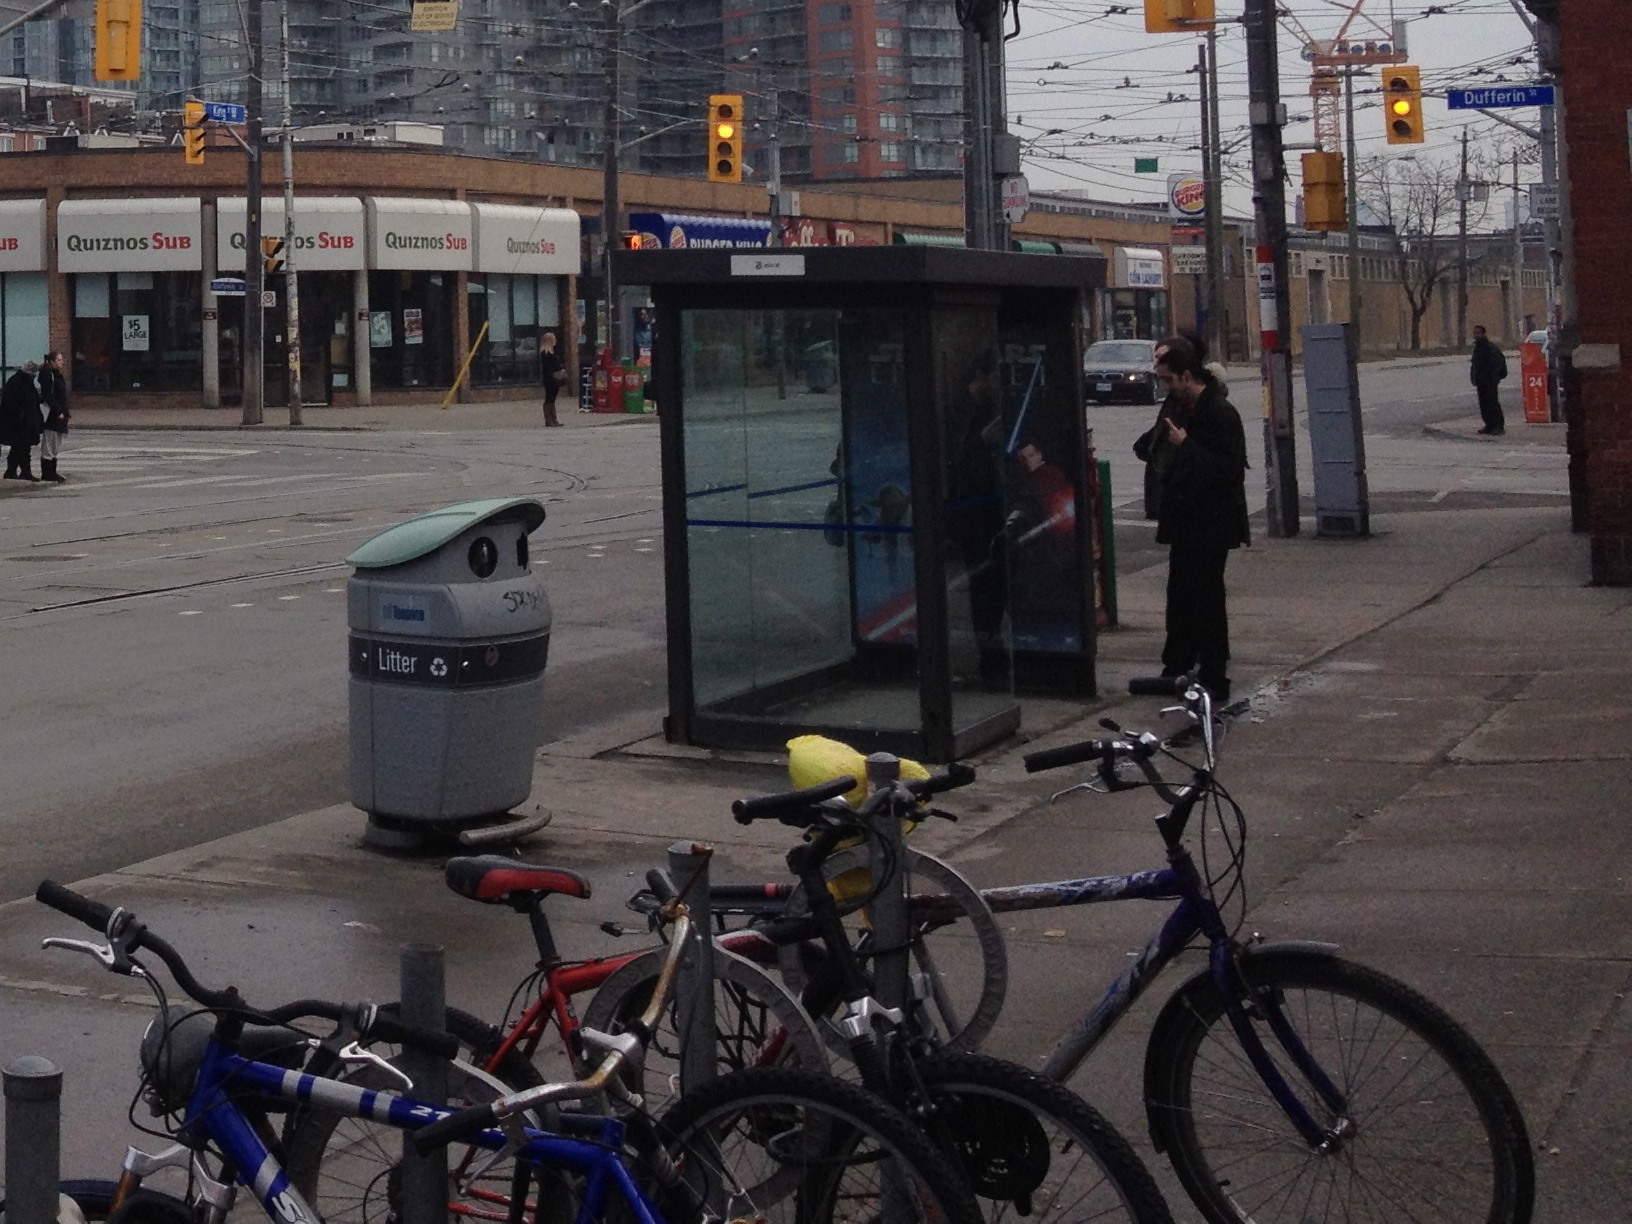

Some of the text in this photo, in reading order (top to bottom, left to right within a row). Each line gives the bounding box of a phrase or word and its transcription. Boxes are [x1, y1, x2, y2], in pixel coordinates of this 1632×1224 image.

[1464, 90, 1526, 105] Dufferin
[1529, 377, 1542, 387] 24
[378, 648, 417, 673] Litter
